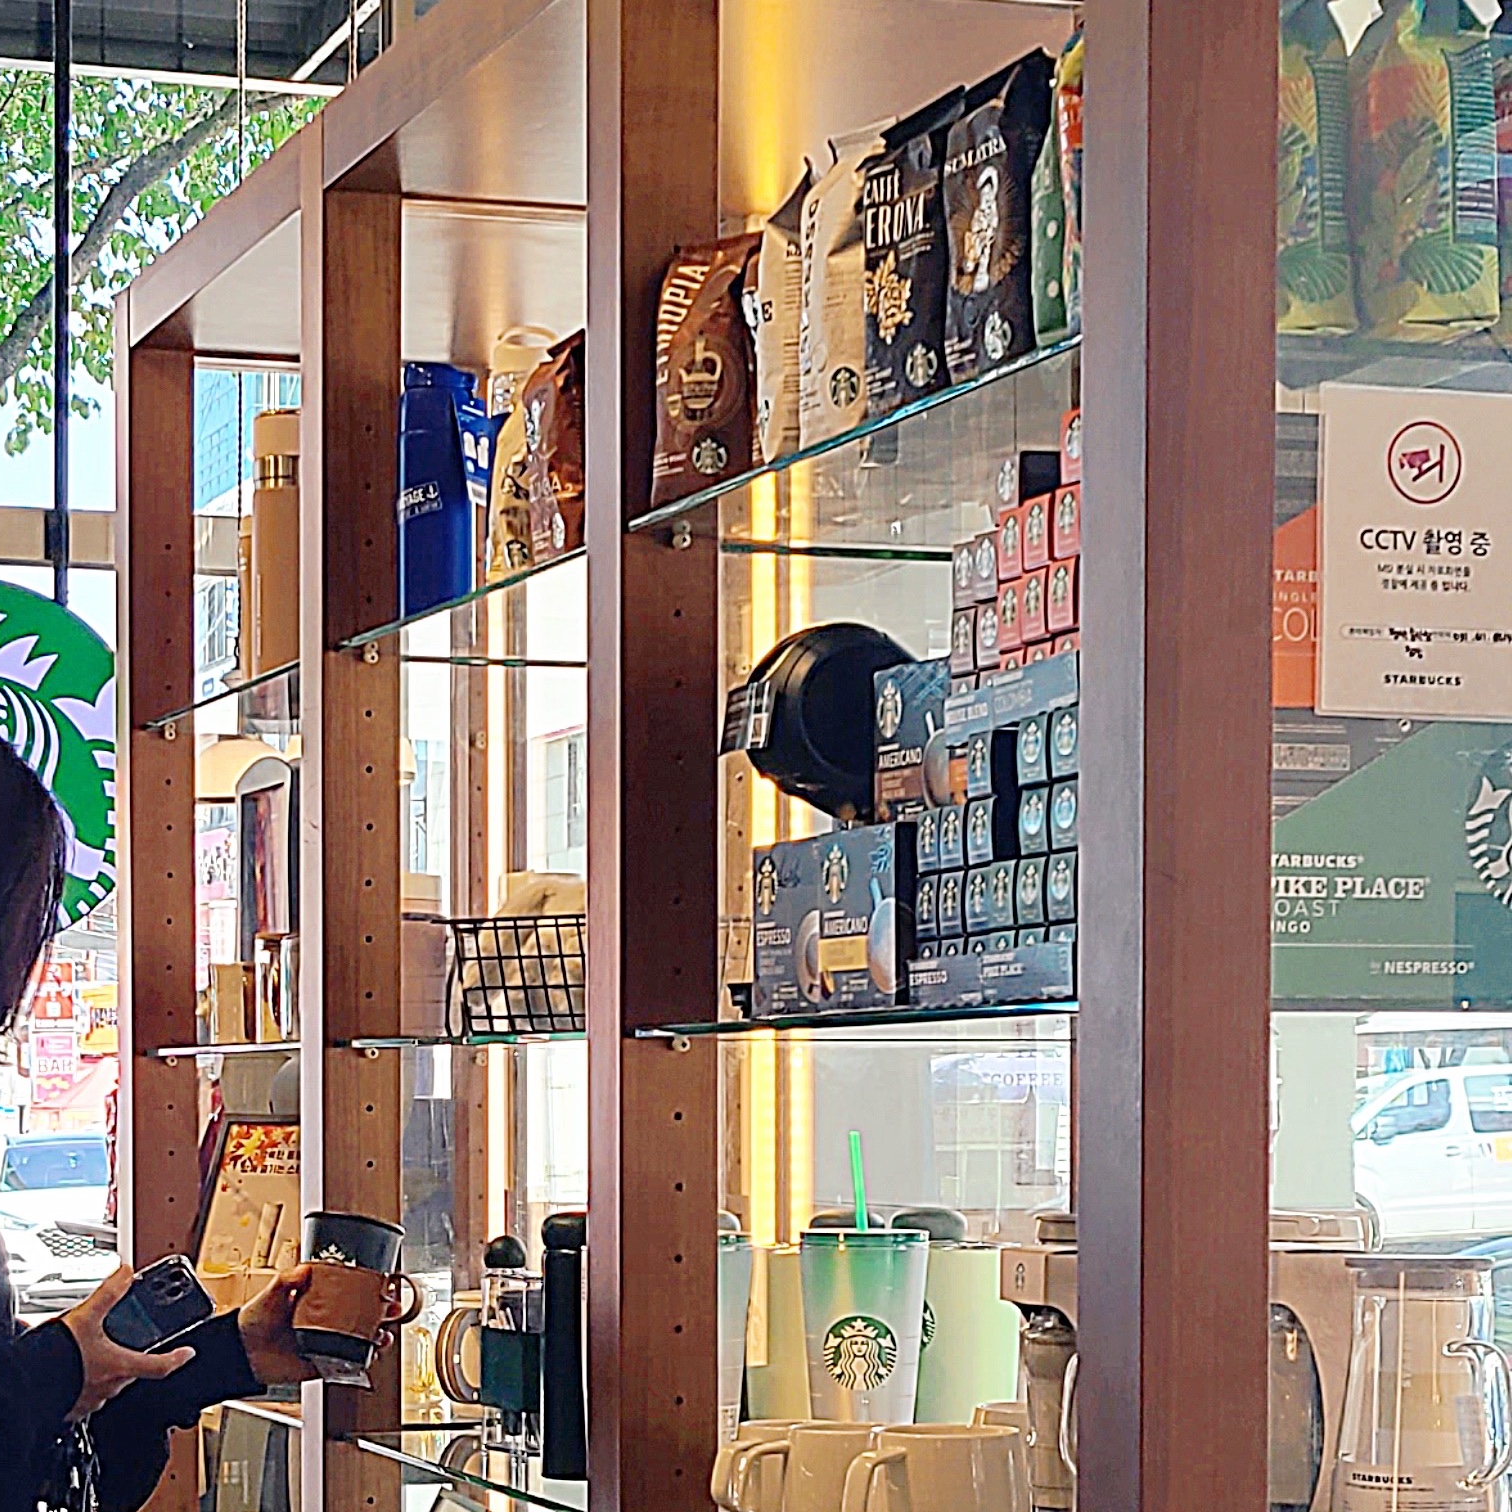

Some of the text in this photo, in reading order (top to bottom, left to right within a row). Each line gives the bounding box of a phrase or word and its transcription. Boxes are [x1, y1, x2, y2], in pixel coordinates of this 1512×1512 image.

[944, 135, 1007, 176] SUMATRA
[1359, 528, 1492, 557] CCTV 촬영 중
[1417, 564, 1426, 576] 시
[1383, 673, 1463, 687] STARBUCKS
[878, 747, 923, 769] AMERICANO
[1334, 876, 1425, 900] PLACE
[824, 916, 869, 936] AMERICANO
[1384, 961, 1469, 975] NESPRESSO
